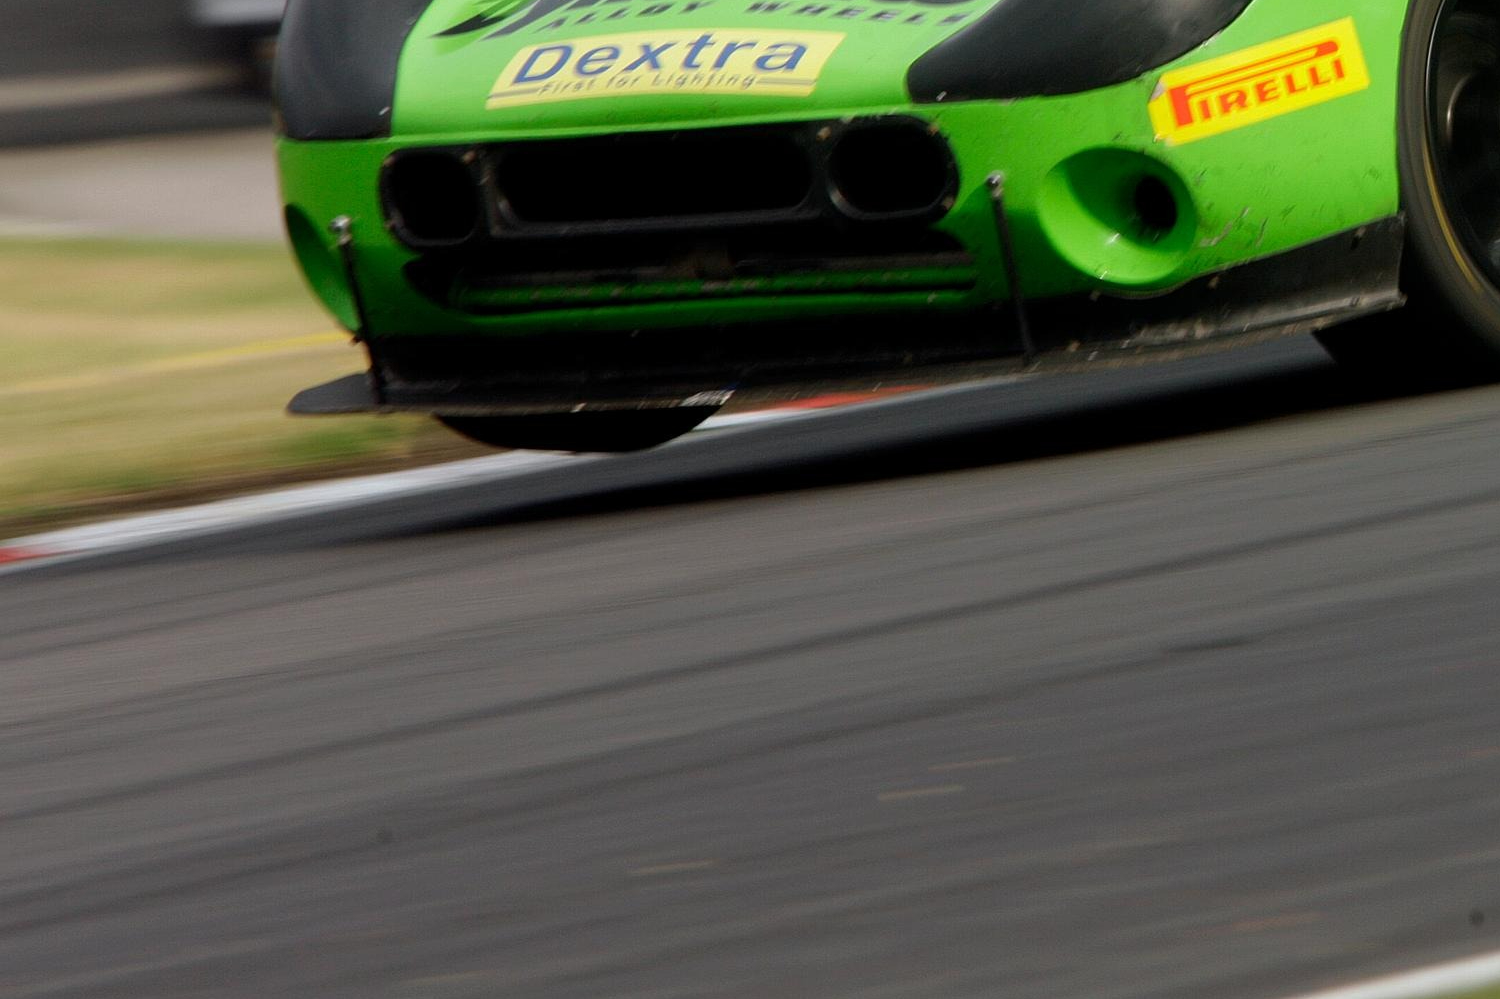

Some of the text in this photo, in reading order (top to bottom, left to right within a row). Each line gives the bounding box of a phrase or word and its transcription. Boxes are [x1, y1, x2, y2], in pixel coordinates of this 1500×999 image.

[512, 33, 807, 85] Dextra
[538, 70, 757, 94] First for Lighting
[1168, 40, 1345, 128] PIRELLI
